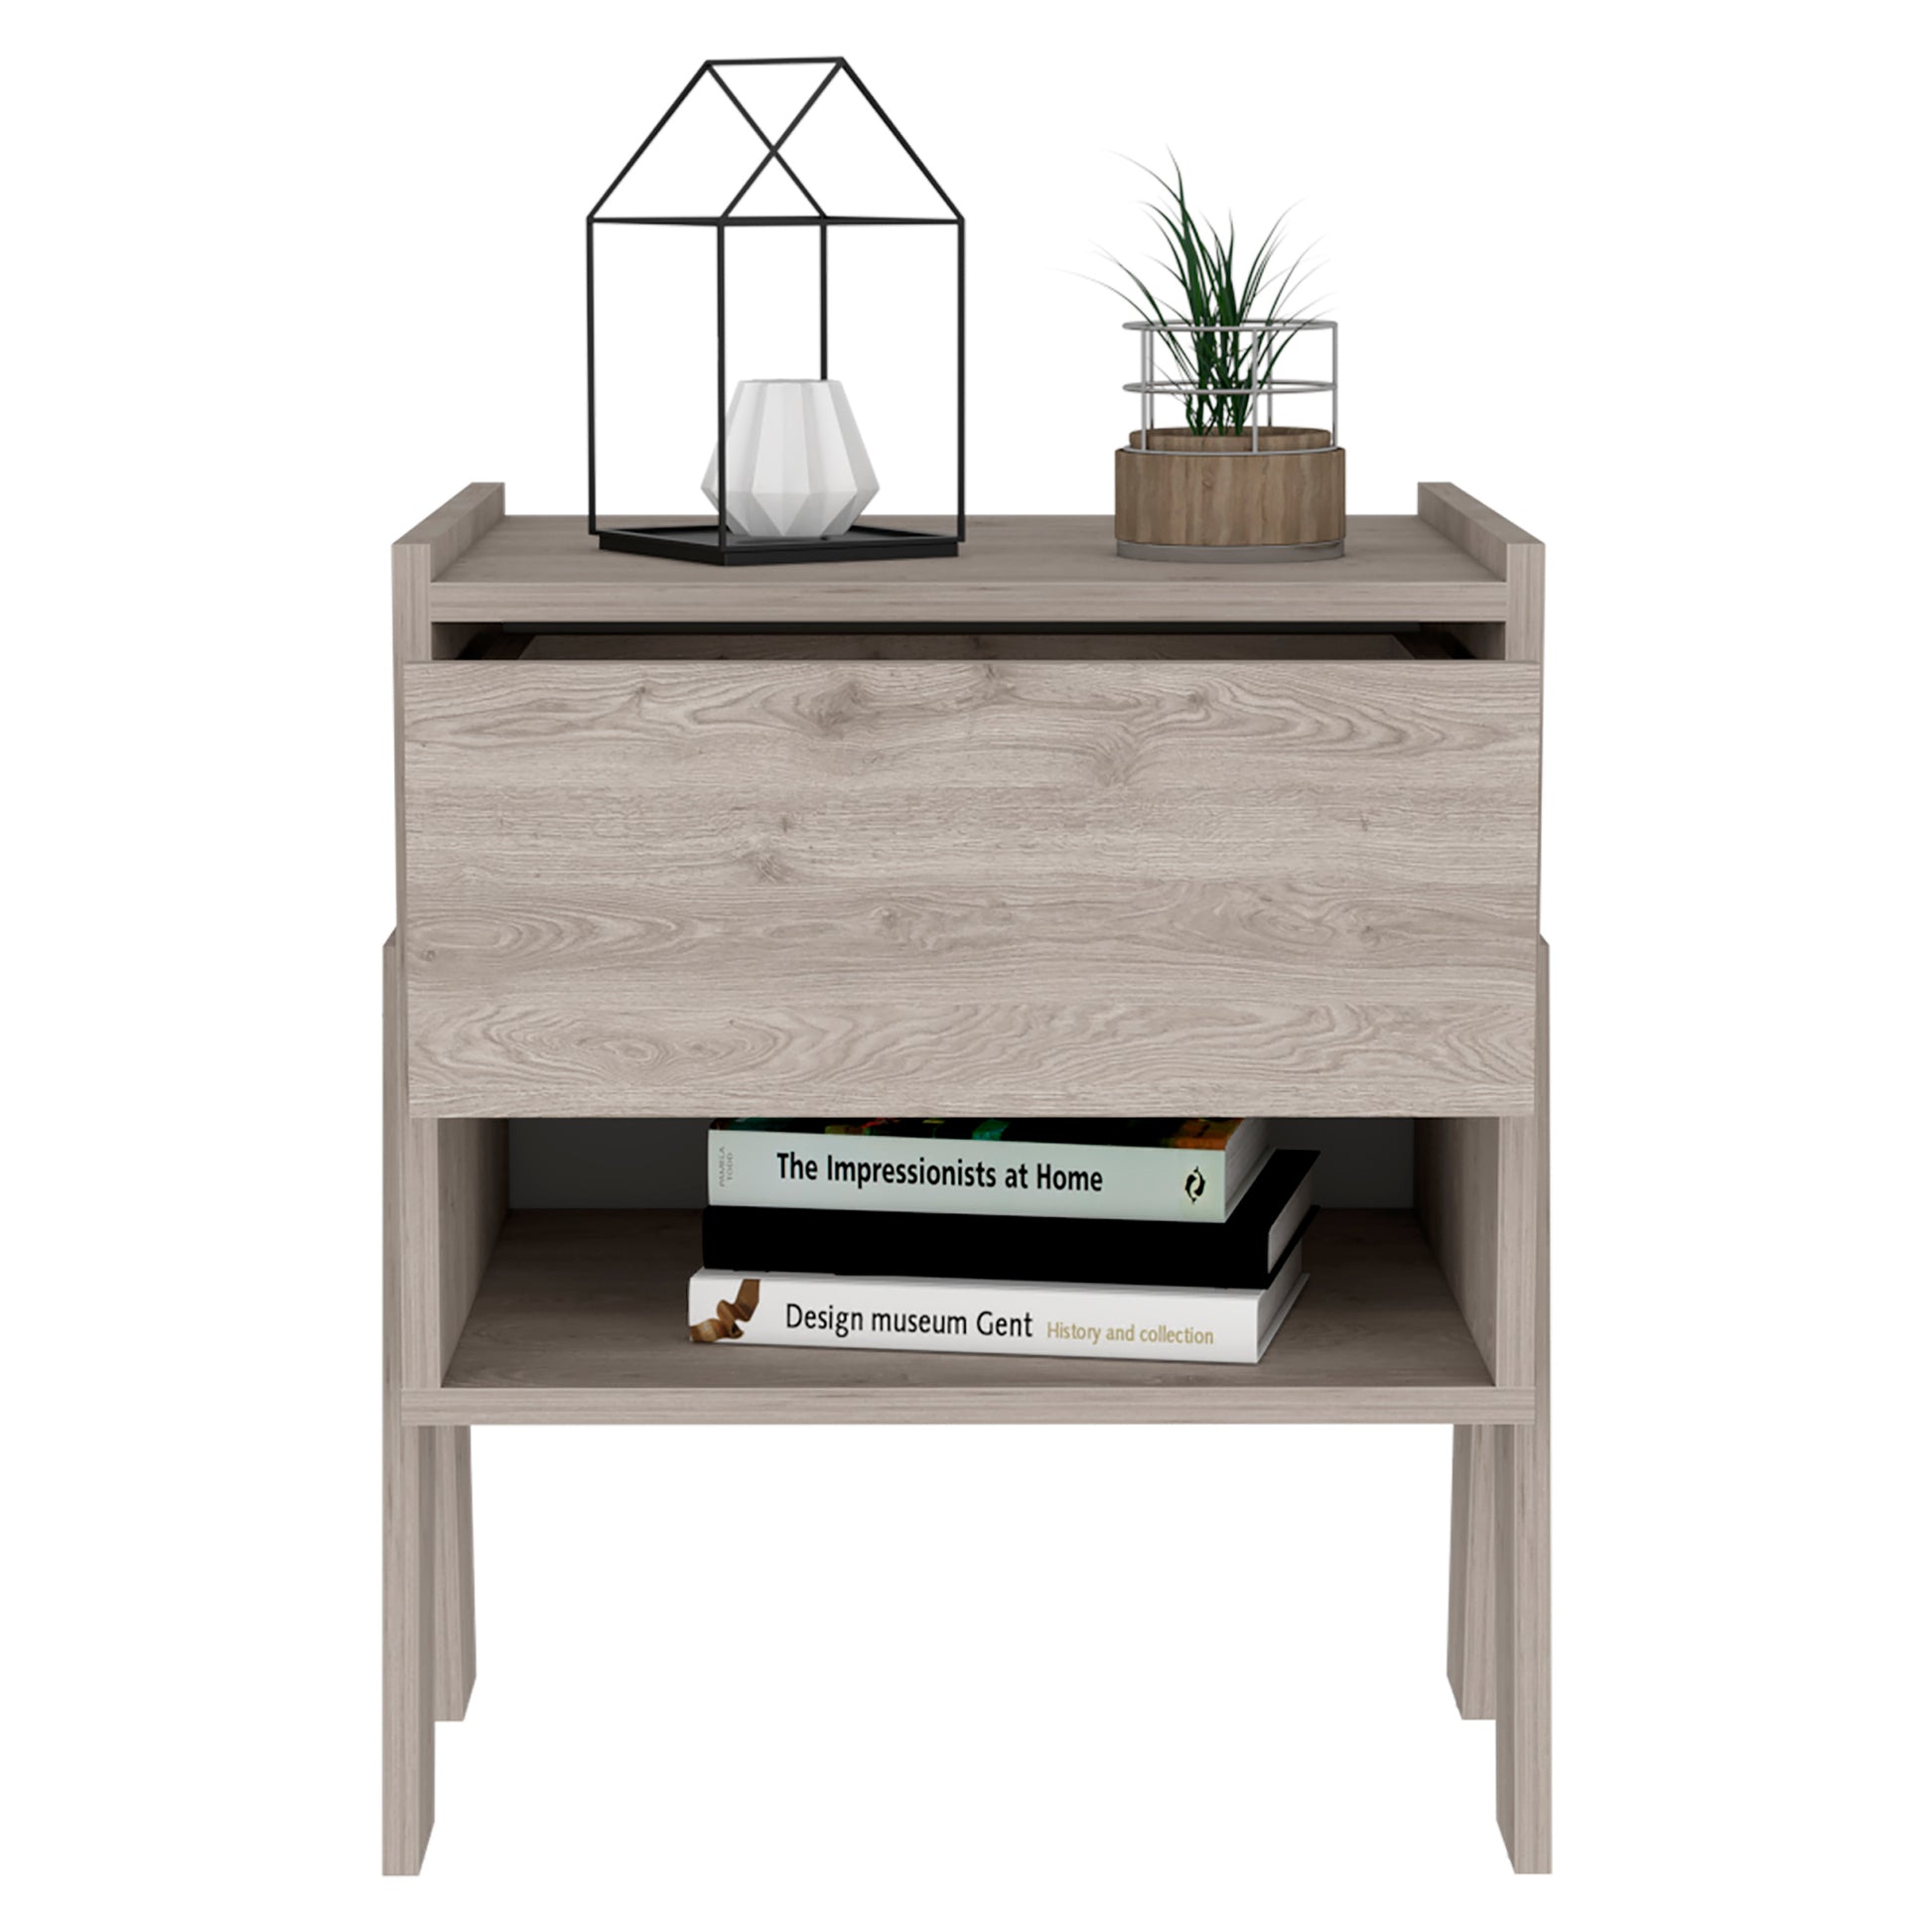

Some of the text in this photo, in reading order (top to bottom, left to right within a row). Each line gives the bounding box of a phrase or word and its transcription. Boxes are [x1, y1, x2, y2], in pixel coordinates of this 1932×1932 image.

[776, 1151, 1103, 1192] The Impressionists at Home
[786, 1304, 1034, 1338] Design museum Gent
[1046, 1320, 1214, 1345] History and collection
